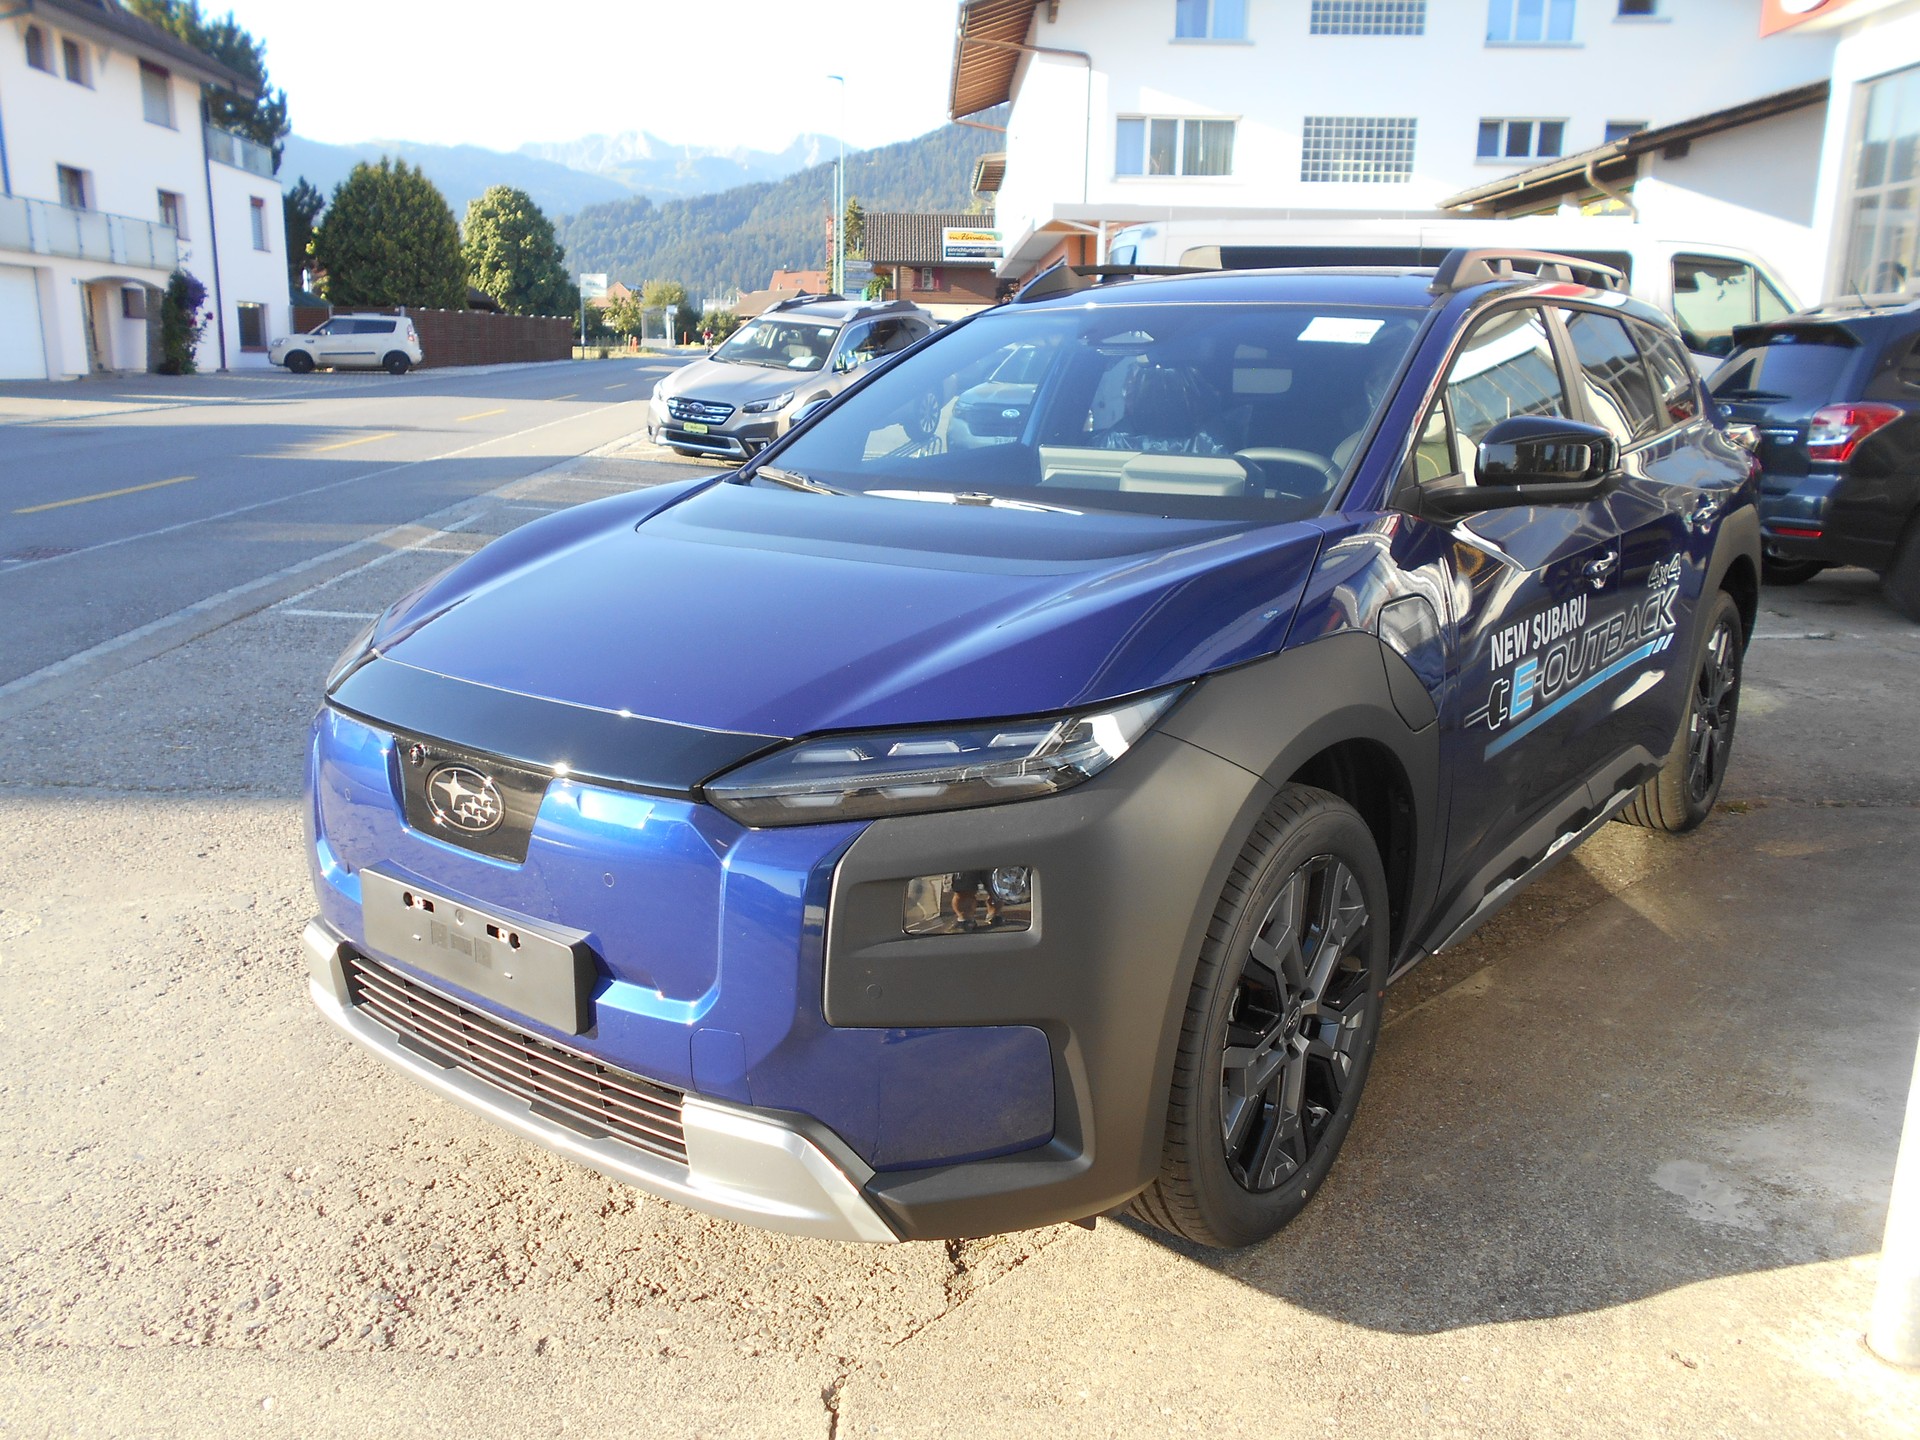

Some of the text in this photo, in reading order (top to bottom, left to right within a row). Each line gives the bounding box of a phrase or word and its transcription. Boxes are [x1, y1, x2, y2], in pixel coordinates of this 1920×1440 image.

[1647, 552, 1682, 590] 4x4
[1491, 593, 1587, 671] NEW SUBARU
